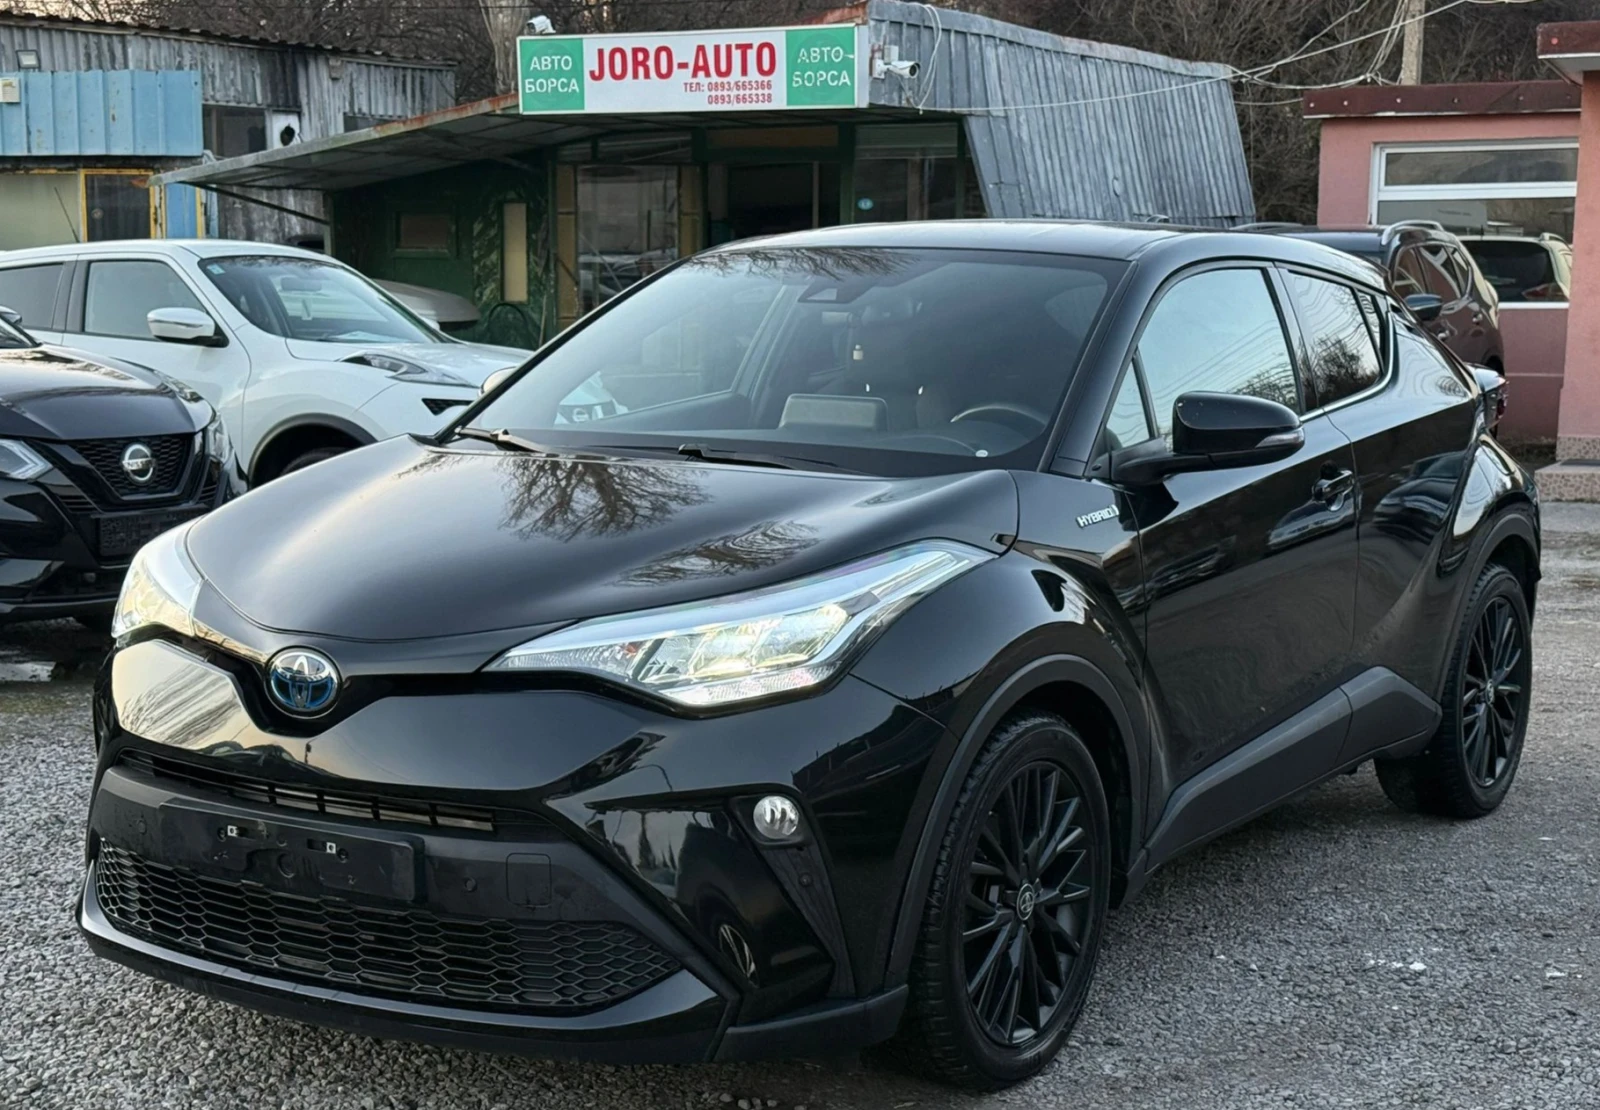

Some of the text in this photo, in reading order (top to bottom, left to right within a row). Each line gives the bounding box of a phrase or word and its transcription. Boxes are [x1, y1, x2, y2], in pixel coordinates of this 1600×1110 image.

[530, 55, 572, 70] АВТО
[589, 42, 776, 81] JORO-AUTO
[797, 46, 843, 63] АВТО
[525, 78, 579, 93] БОРСА
[683, 80, 772, 92] ТЕЛ: 0893/665366
[792, 70, 851, 87] БОРСА
[707, 93, 772, 105] 0893/665338
[1076, 507, 1114, 527] HYBRID
